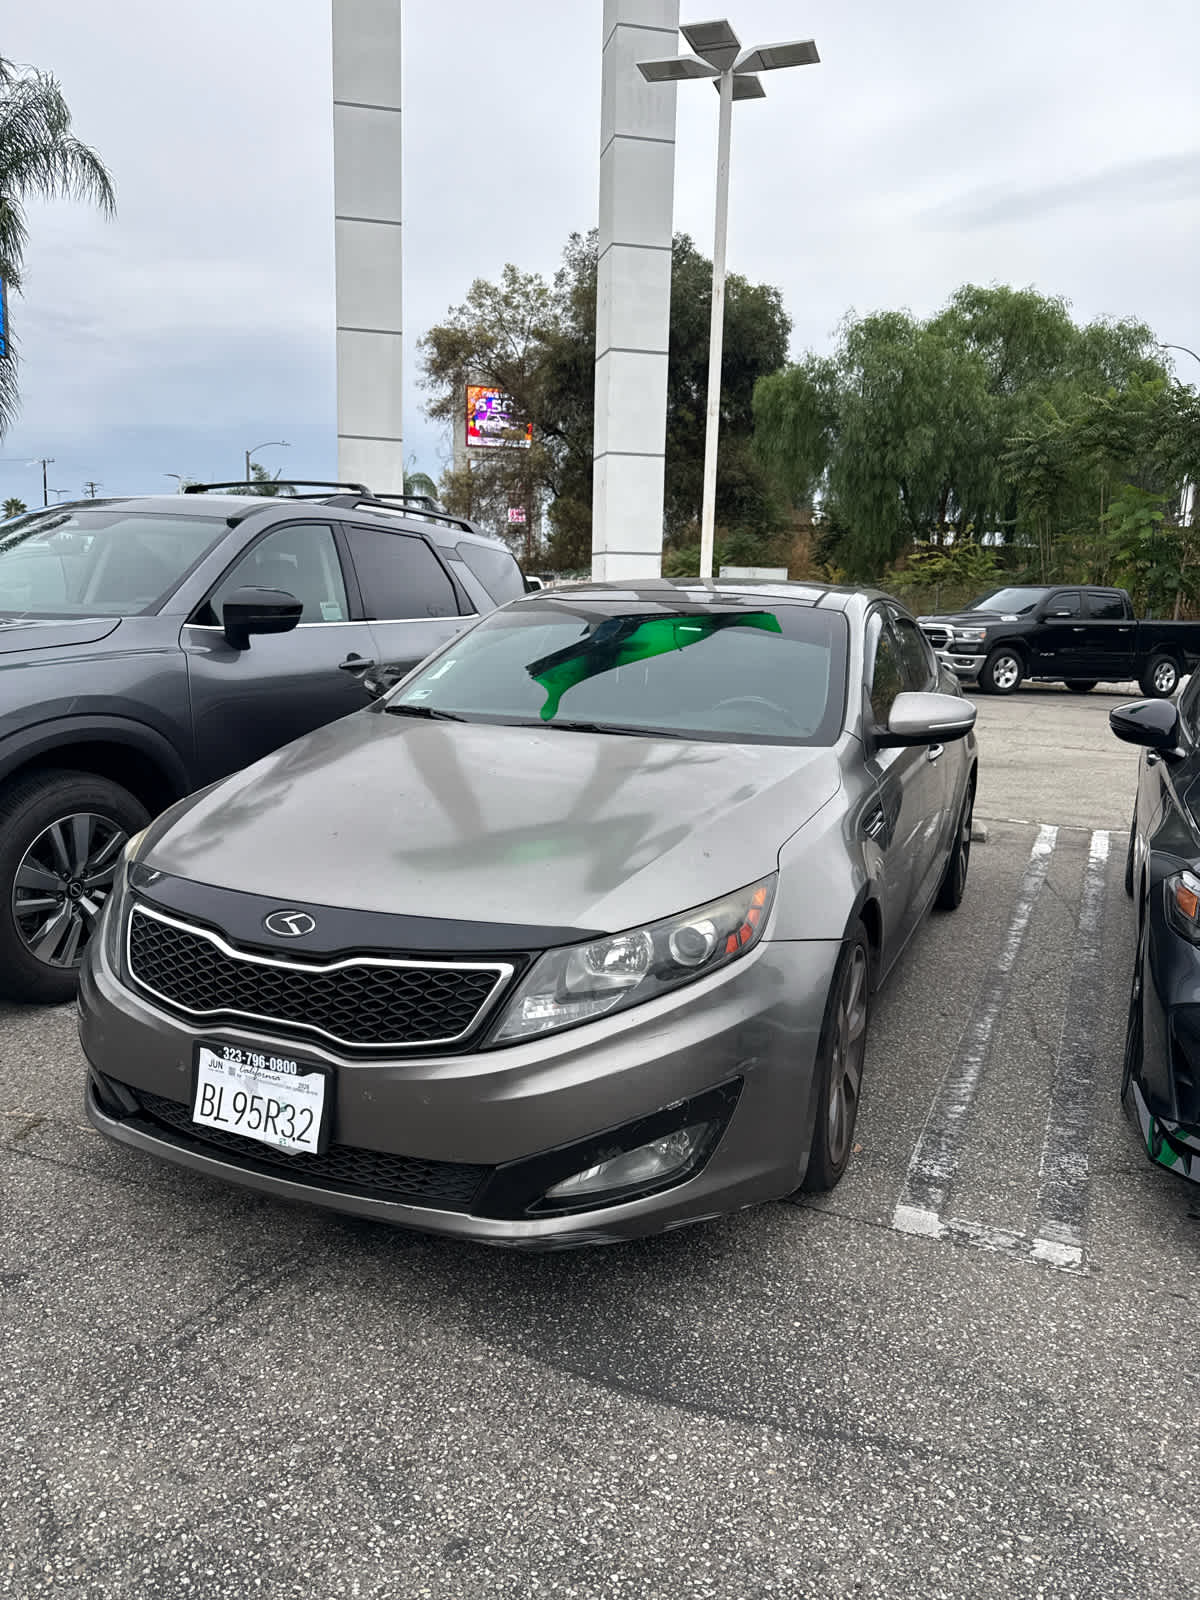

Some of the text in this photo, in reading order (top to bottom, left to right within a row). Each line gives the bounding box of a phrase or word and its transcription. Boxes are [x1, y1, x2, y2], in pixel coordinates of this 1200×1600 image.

[208, 1059, 223, 1070] JUN
[222, 1046, 297, 1075] 323-796-0800
[239, 1063, 281, 1081] California
[200, 1082, 314, 1144] BL95R32
